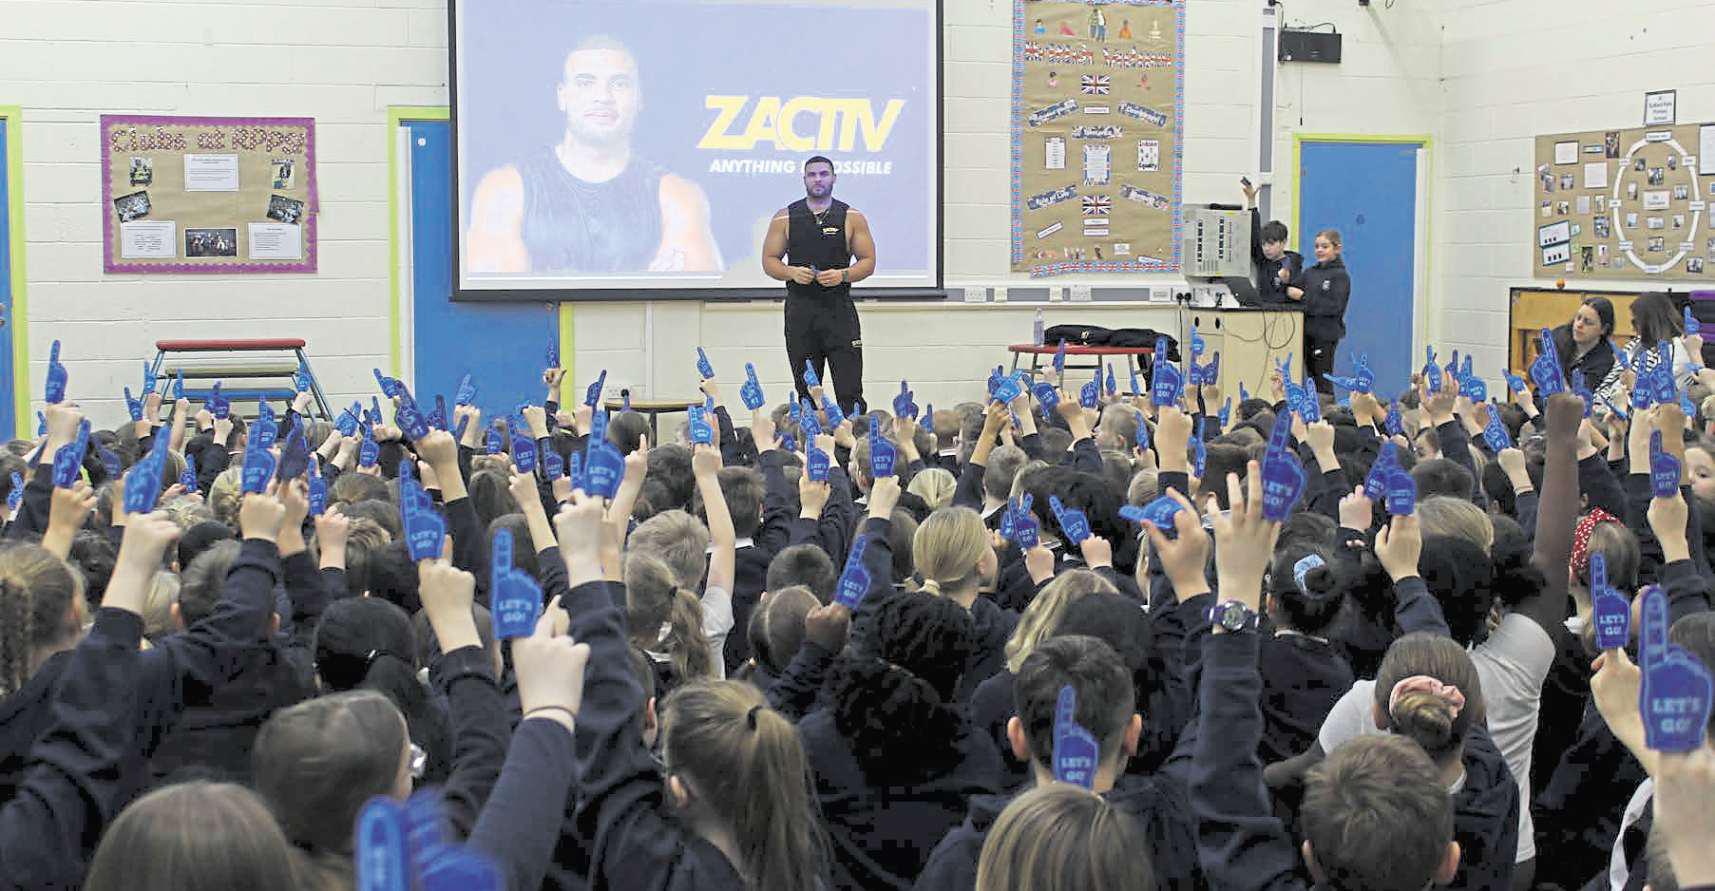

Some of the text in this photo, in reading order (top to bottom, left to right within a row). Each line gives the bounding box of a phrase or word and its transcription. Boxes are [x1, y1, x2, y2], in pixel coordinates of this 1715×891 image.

[696, 94, 906, 153] ZACTIV
[112, 125, 187, 152] Clubs
[709, 159, 796, 174] ANYTHING
[834, 160, 893, 175] OSSIBLE
[499, 599, 532, 611] LET'S
[503, 611, 526, 623] GO!
[1600, 614, 1625, 624] LET'S
[1652, 697, 1700, 713] LET'S
[1061, 757, 1091, 769] LET'S
